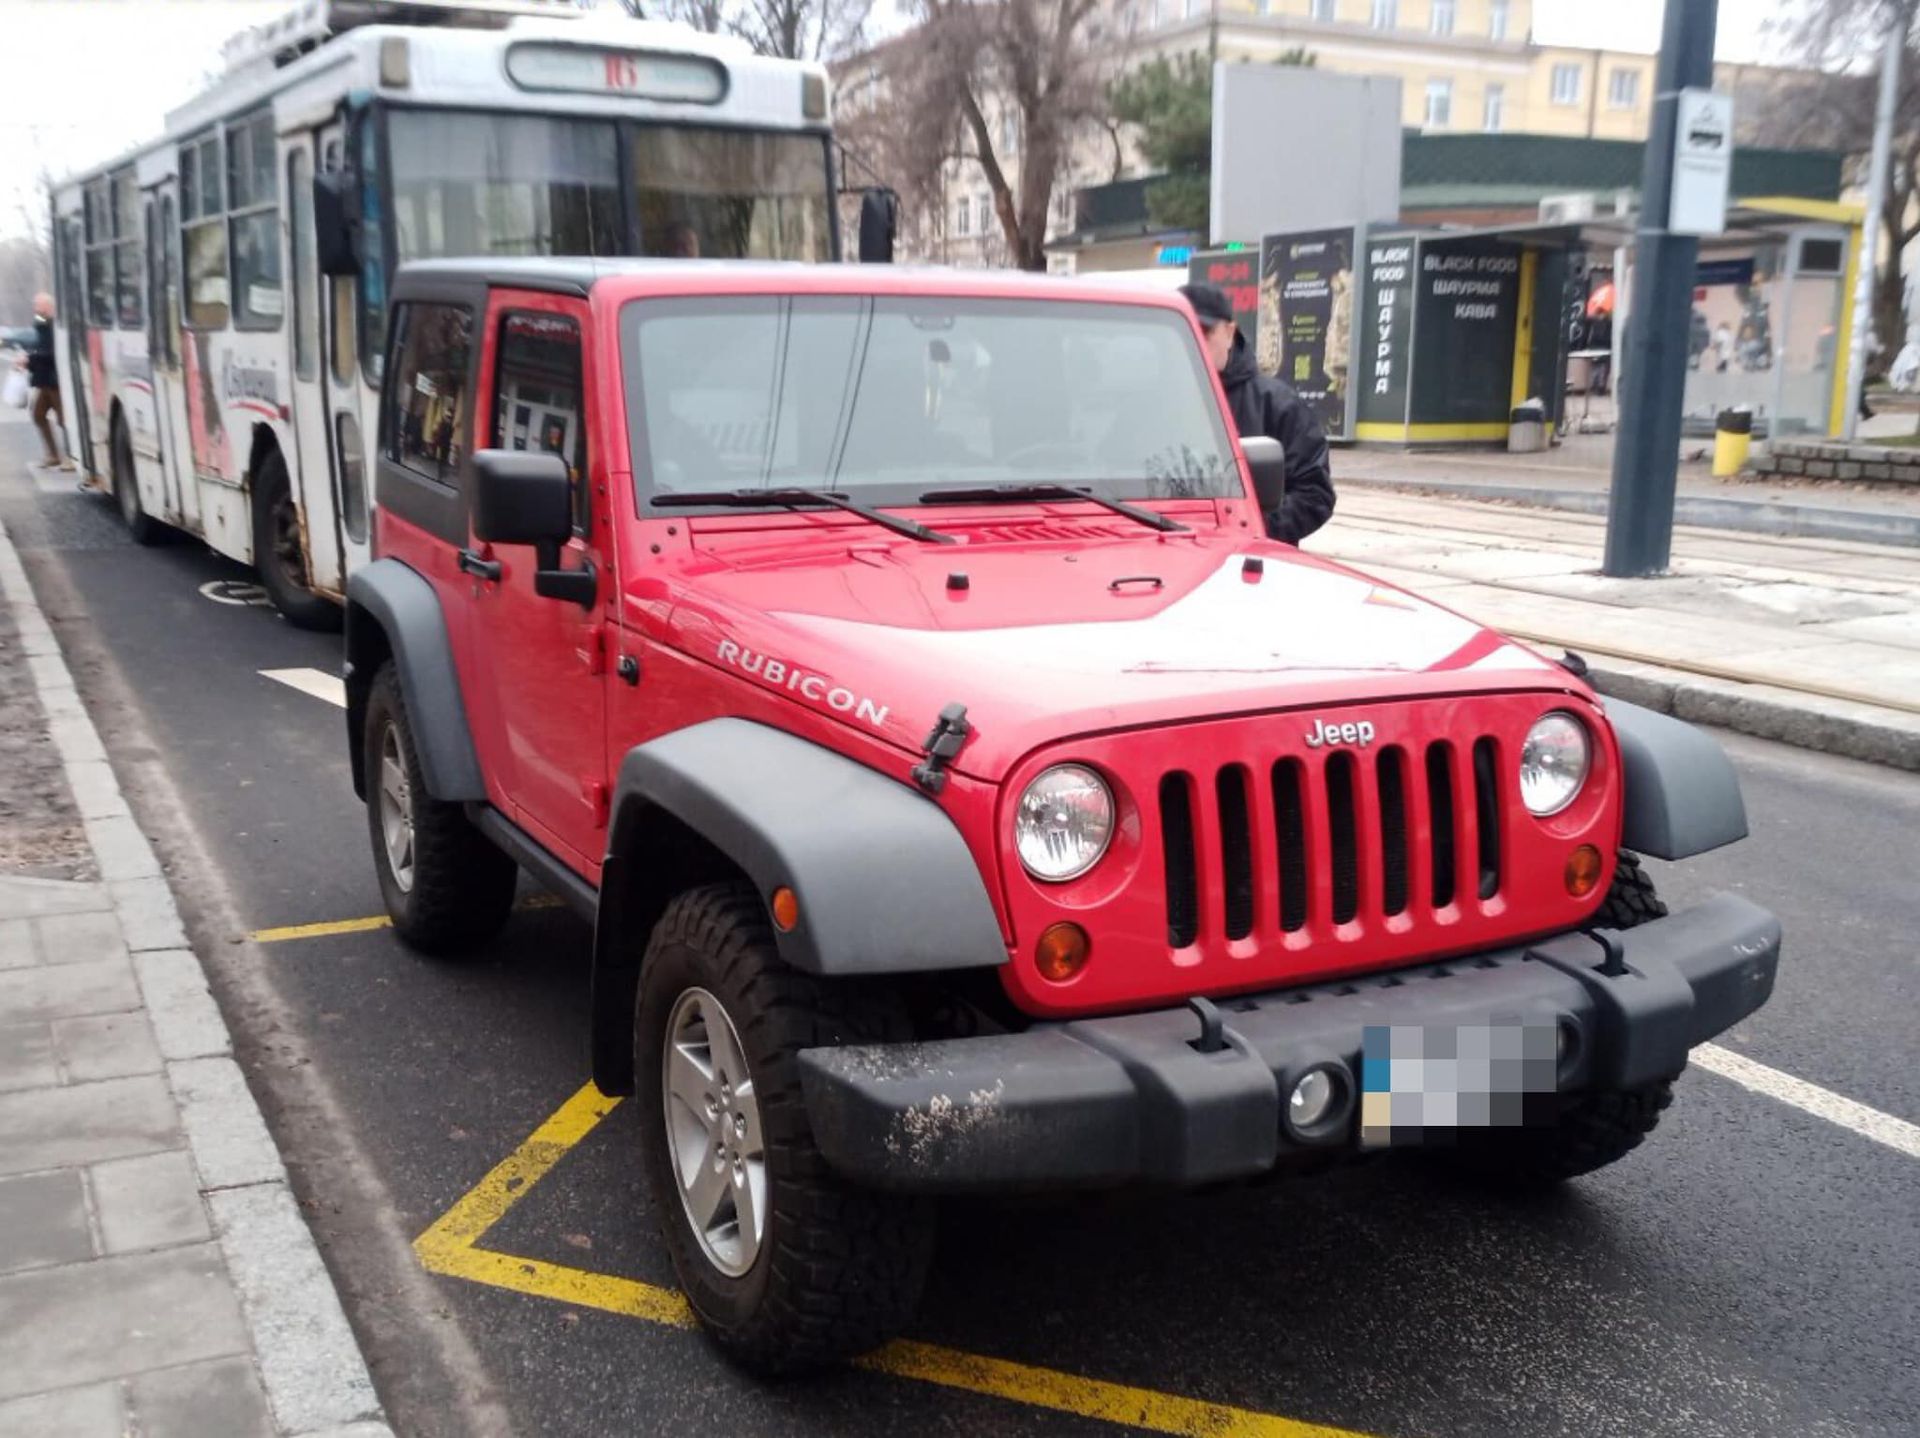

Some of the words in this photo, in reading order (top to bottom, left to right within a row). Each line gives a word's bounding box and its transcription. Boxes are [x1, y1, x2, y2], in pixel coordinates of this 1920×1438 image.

[1371, 247, 1410, 265] BLACK
[1424, 254, 1475, 272] BLACK
[1477, 256, 1518, 273] FOOD
[1373, 266, 1405, 283] FOOD
[1432, 279, 1500, 296] ШАУРМА
[1454, 302, 1497, 319] КАВА
[1375, 288, 1396, 394] ШАУРМА
[716, 639, 889, 726] RUBICON
[1304, 718, 1375, 748] Jeep
